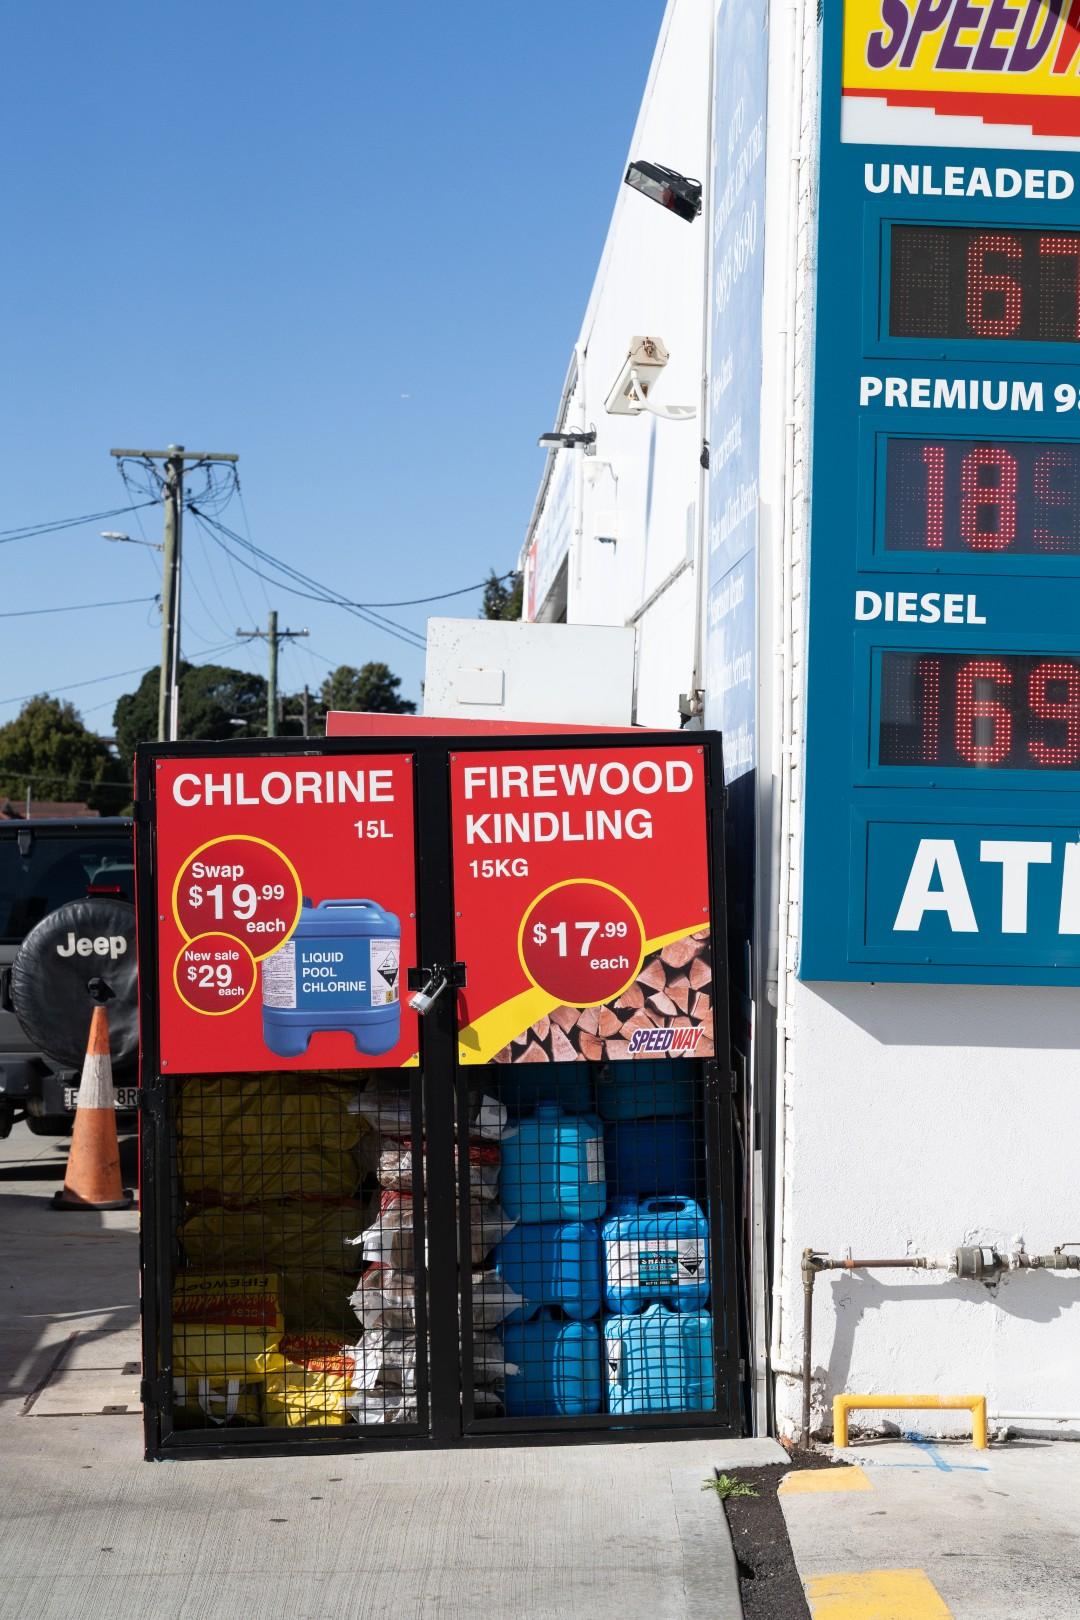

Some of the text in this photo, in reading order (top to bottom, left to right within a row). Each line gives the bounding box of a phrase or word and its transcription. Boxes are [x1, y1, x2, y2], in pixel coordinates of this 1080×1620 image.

[865, 0, 1080, 76] SPEED
[735, 113, 763, 197] CENTRE
[863, 162, 1075, 200] UNLEADED
[859, 376, 1080, 413] PREMIUM 9
[854, 590, 987, 625] DIESEL
[172, 769, 395, 807] CHLORINE
[463, 760, 693, 799] FIREWOOD
[354, 819, 394, 839] 15L
[465, 808, 653, 844] KINDLING
[191, 862, 244, 881] Swap
[469, 857, 529, 878] 15KG
[892, 838, 1080, 935] AT
[246, 918, 286, 933] each
[56, 932, 128, 960] Jeep
[184, 950, 240, 961] New sale
[302, 952, 344, 963] LIQUID
[302, 967, 337, 978] POOL
[590, 955, 629, 970] each
[187, 964, 233, 988] $29
[302, 981, 367, 993] CHLORINE
[218, 985, 245, 997] each
[628, 1027, 704, 1053] SPEEDWAY
